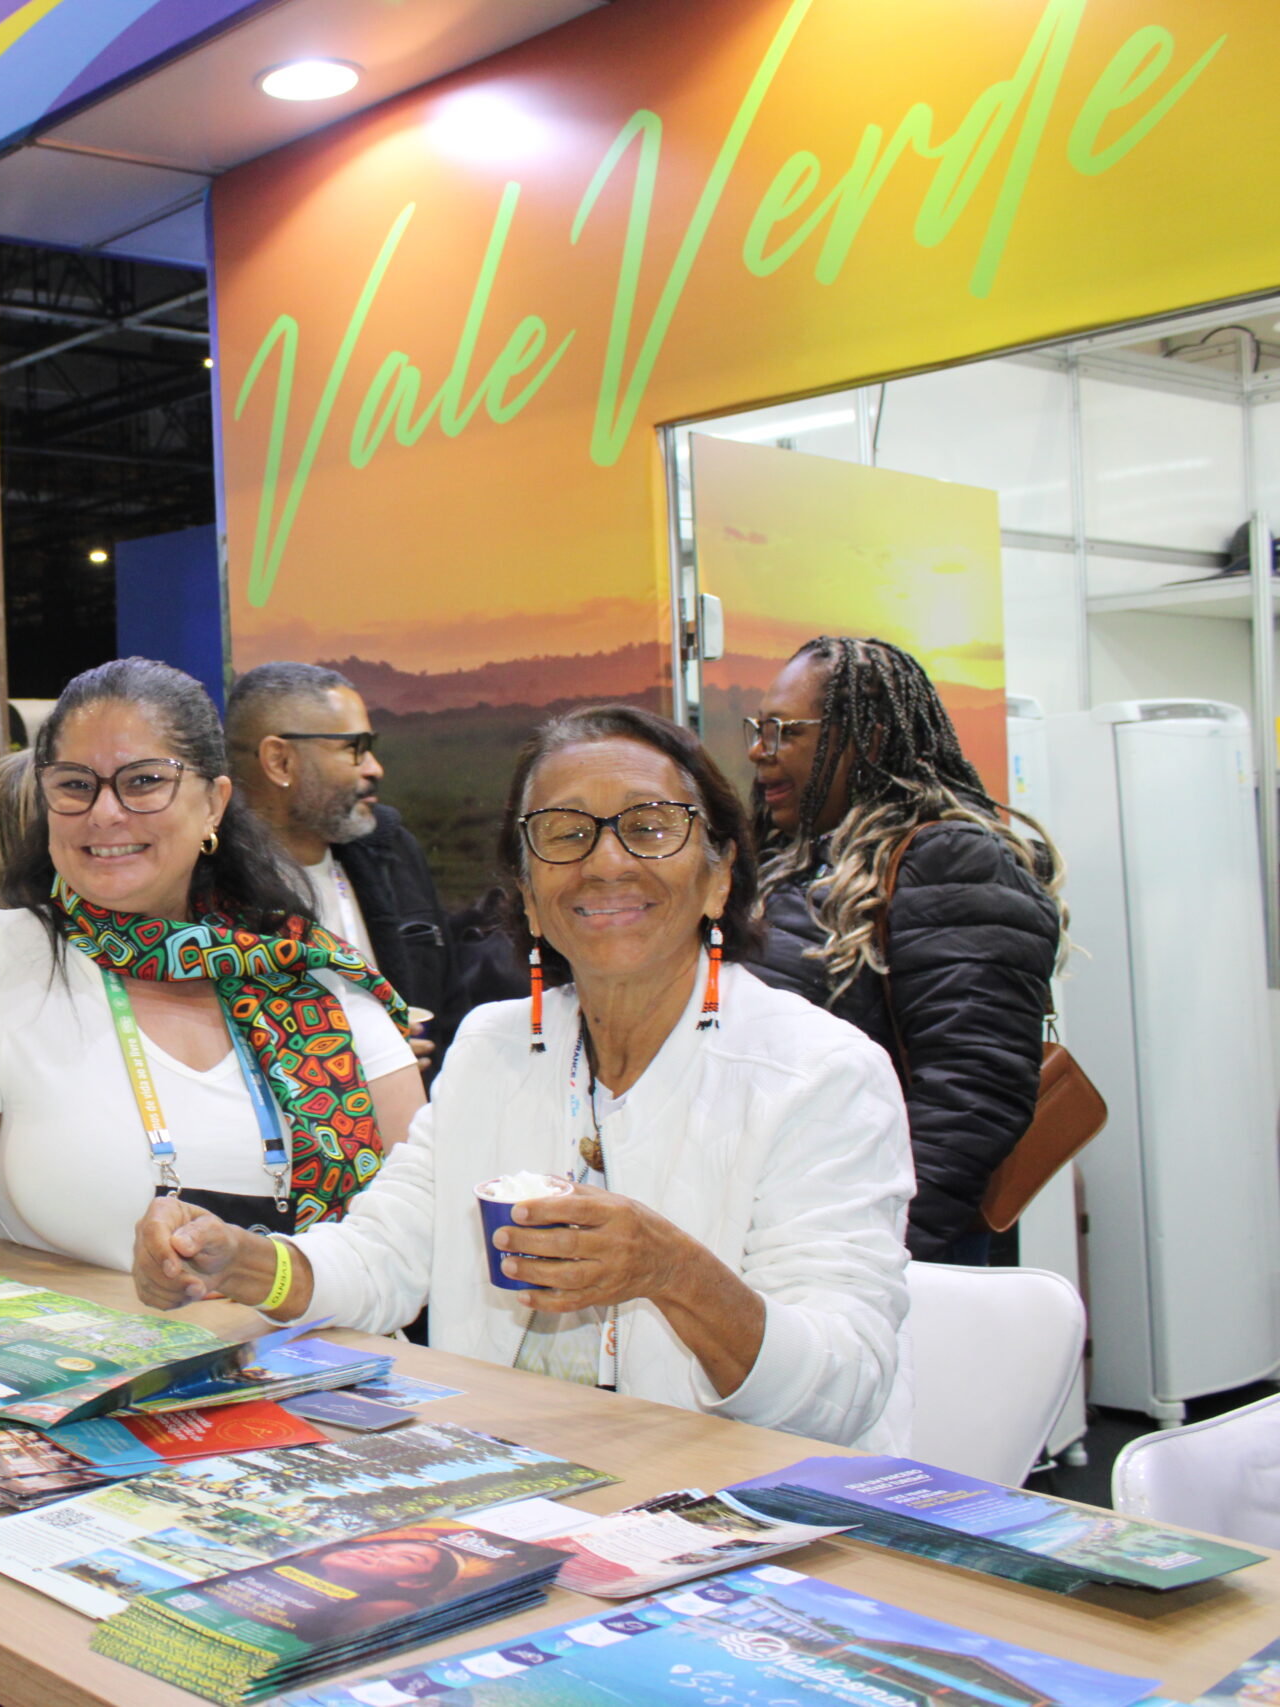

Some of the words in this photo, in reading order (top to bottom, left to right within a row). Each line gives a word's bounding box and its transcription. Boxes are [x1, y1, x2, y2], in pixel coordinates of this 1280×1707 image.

[235, 183, 576, 609] Vale
[570, 0, 1228, 468] Verde
[128, 1038, 141, 1057] livre
[133, 1058, 144, 1067] ar
[137, 1068, 148, 1079] ao
[139, 1080, 154, 1100] vida
[145, 1100, 158, 1112] de
